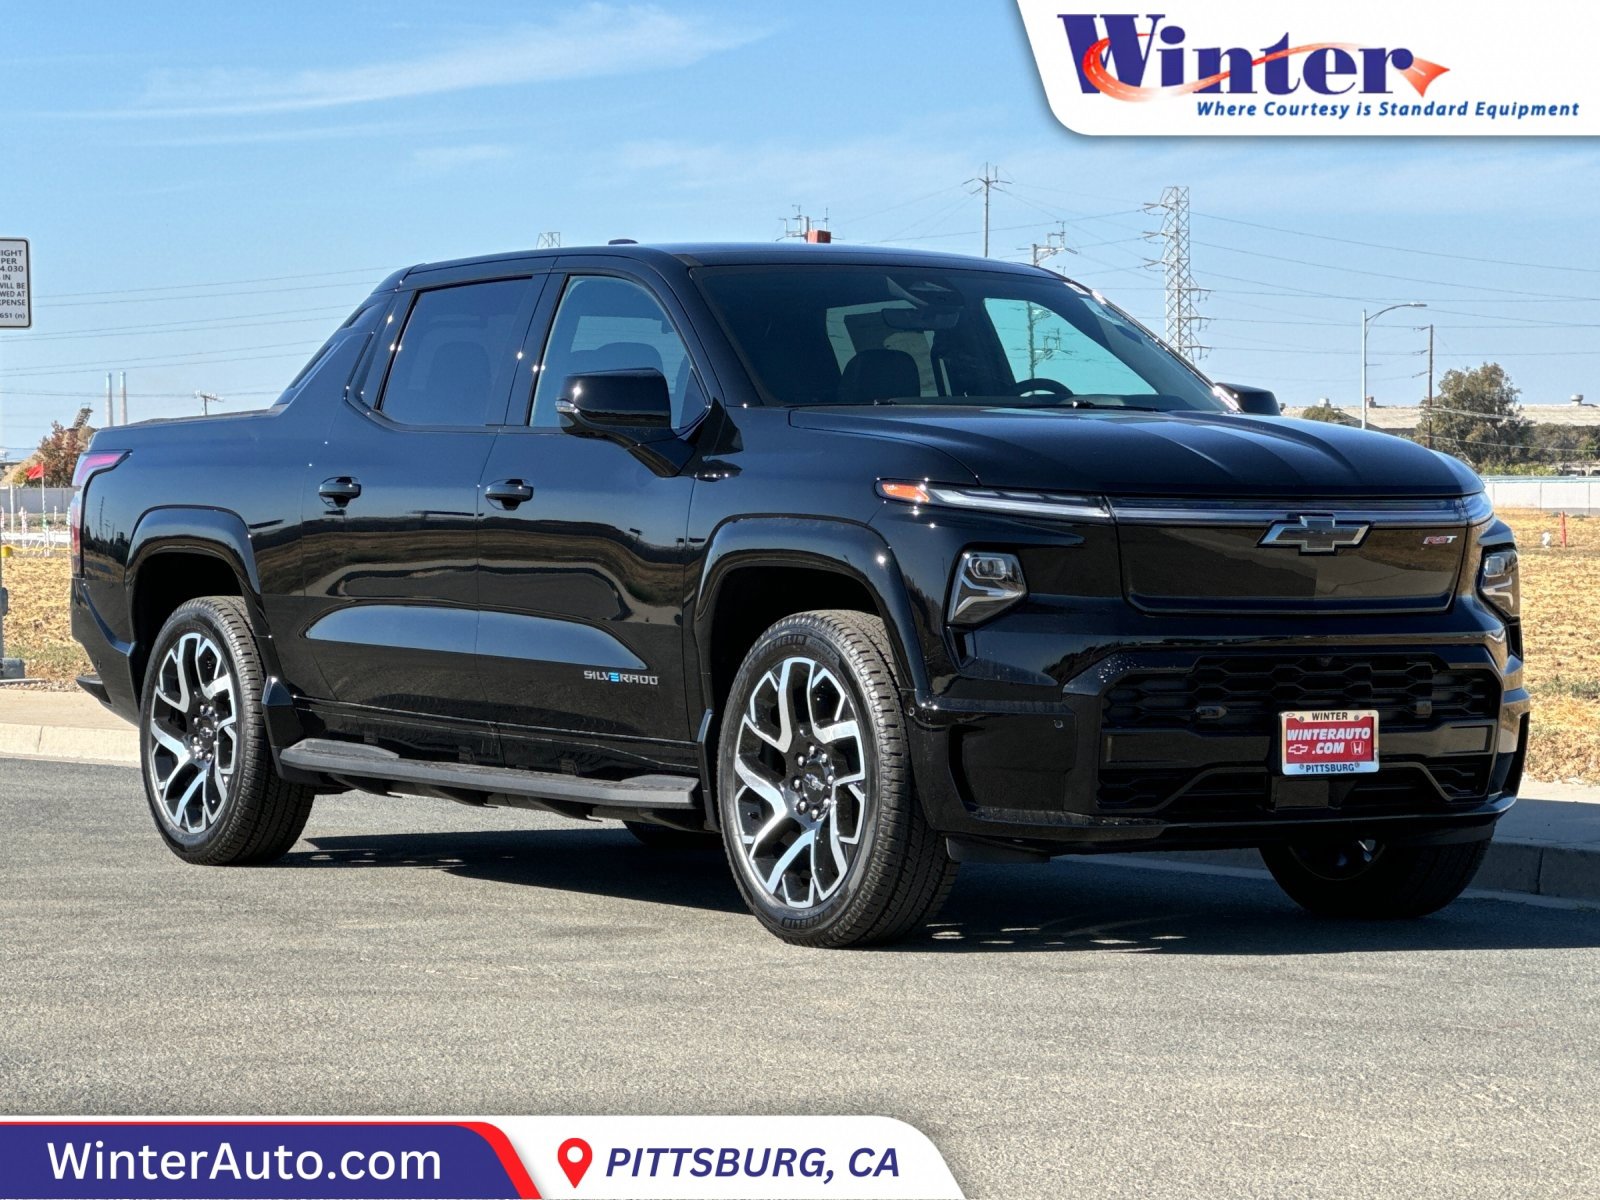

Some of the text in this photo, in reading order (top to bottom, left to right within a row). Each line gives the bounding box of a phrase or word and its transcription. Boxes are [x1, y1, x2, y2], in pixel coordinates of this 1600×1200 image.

[0, 257, 17, 265] PER
[16, 282, 25, 290] BE
[16, 290, 26, 298] AT
[583, 669, 659, 686] SILVERADO
[1311, 711, 1348, 721] WINTER
[1286, 727, 1371, 741] WINTERAUTO
[1311, 741, 1345, 755] .COM
[1305, 763, 1355, 773] PITTSBURG
